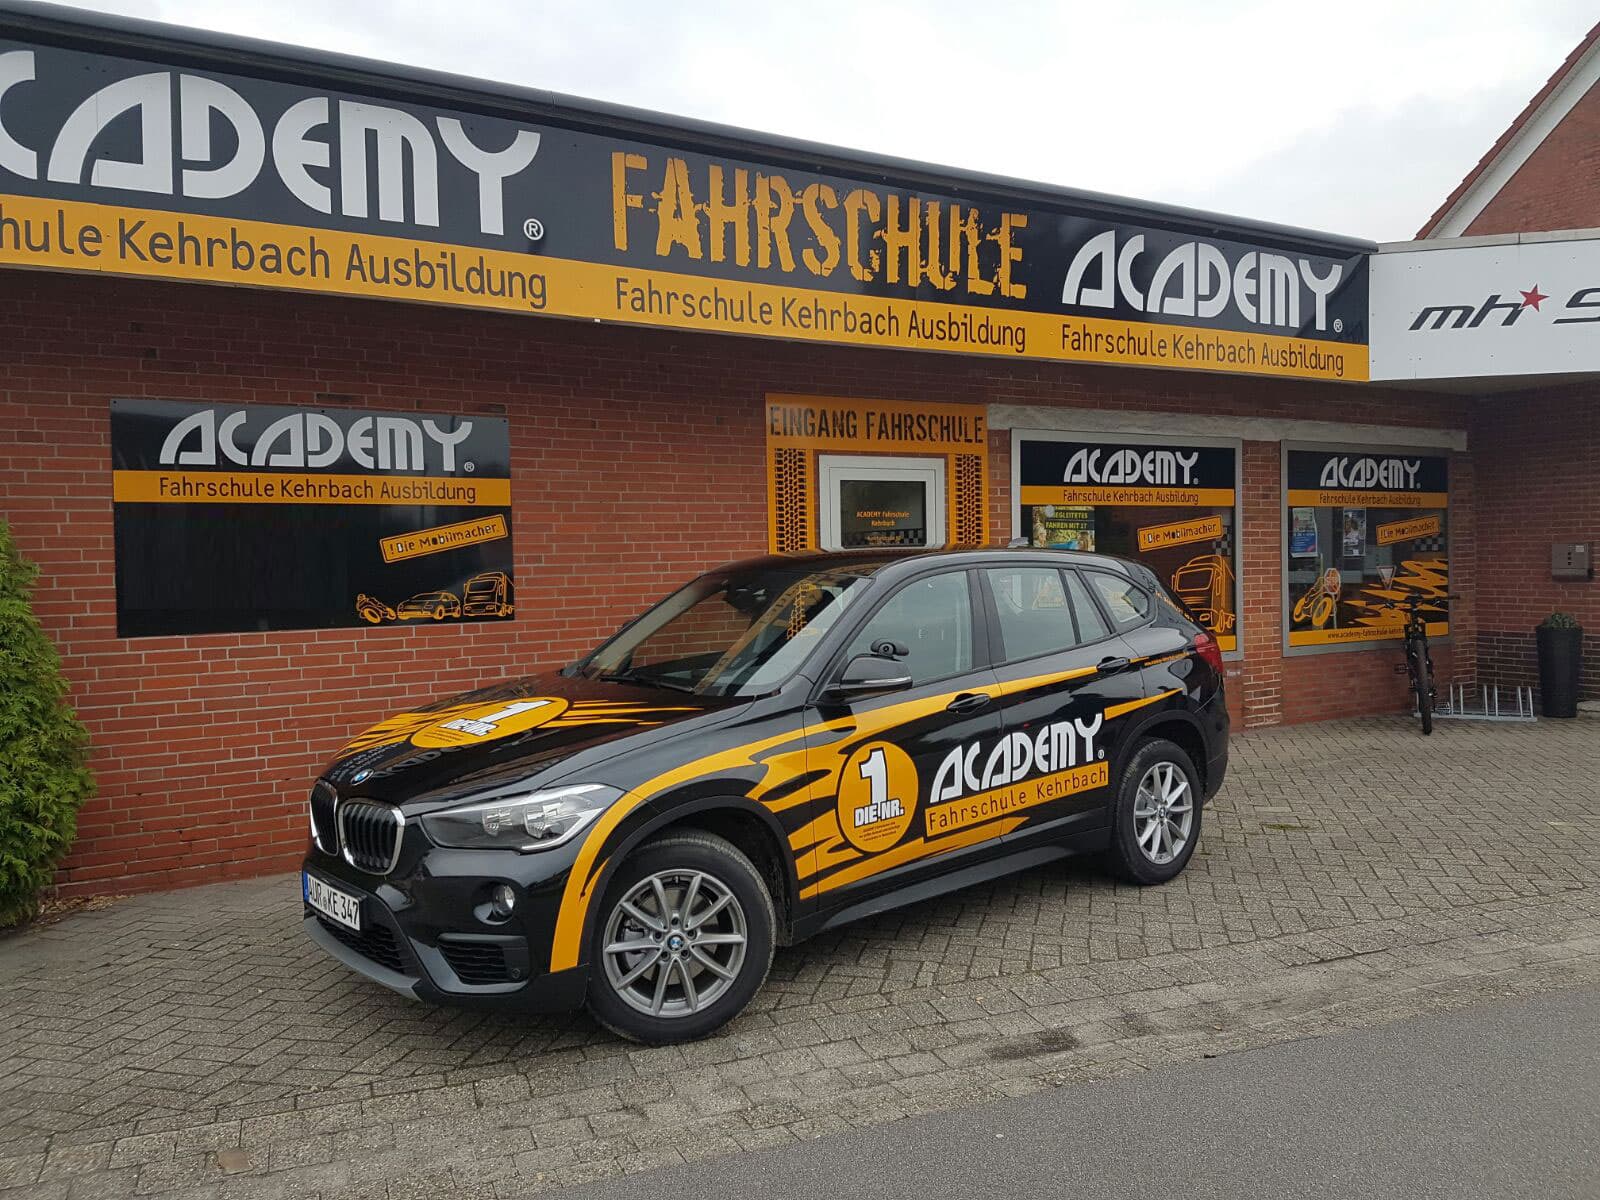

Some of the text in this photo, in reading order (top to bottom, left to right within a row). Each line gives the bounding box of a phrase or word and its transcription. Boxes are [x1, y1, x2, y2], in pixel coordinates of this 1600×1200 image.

[611, 151, 1028, 299] FAHRSCHULE
[119, 218, 330, 278] Kehrbach
[345, 243, 547, 309] Ausbildung
[1062, 230, 1342, 331] ACADEMY
[616, 278, 1027, 353] Fahrschule Kehrbach Ausbildung
[1062, 324, 1344, 377] Fahrschule Kehrbach Ausbildung
[159, 409, 473, 472] ACADEMY
[770, 406, 984, 443] EINGANG FAHRSCHULE
[160, 477, 476, 504] Fahrschule Kehrbach Ausbildung
[1064, 448, 1198, 485] ACADEMY
[1320, 456, 1421, 489] ACADEMY
[1063, 489, 1199, 505] Fahrschule Kehrbach Ausbildung
[1319, 493, 1356, 504] Fahrschule
[1357, 493, 1388, 505] Kehrbach
[859, 748, 888, 805] 1
[930, 713, 1103, 803] ACADEMY
[929, 767, 1107, 831] Fahrschule Kehrbach
[341, 895, 359, 925] 347
